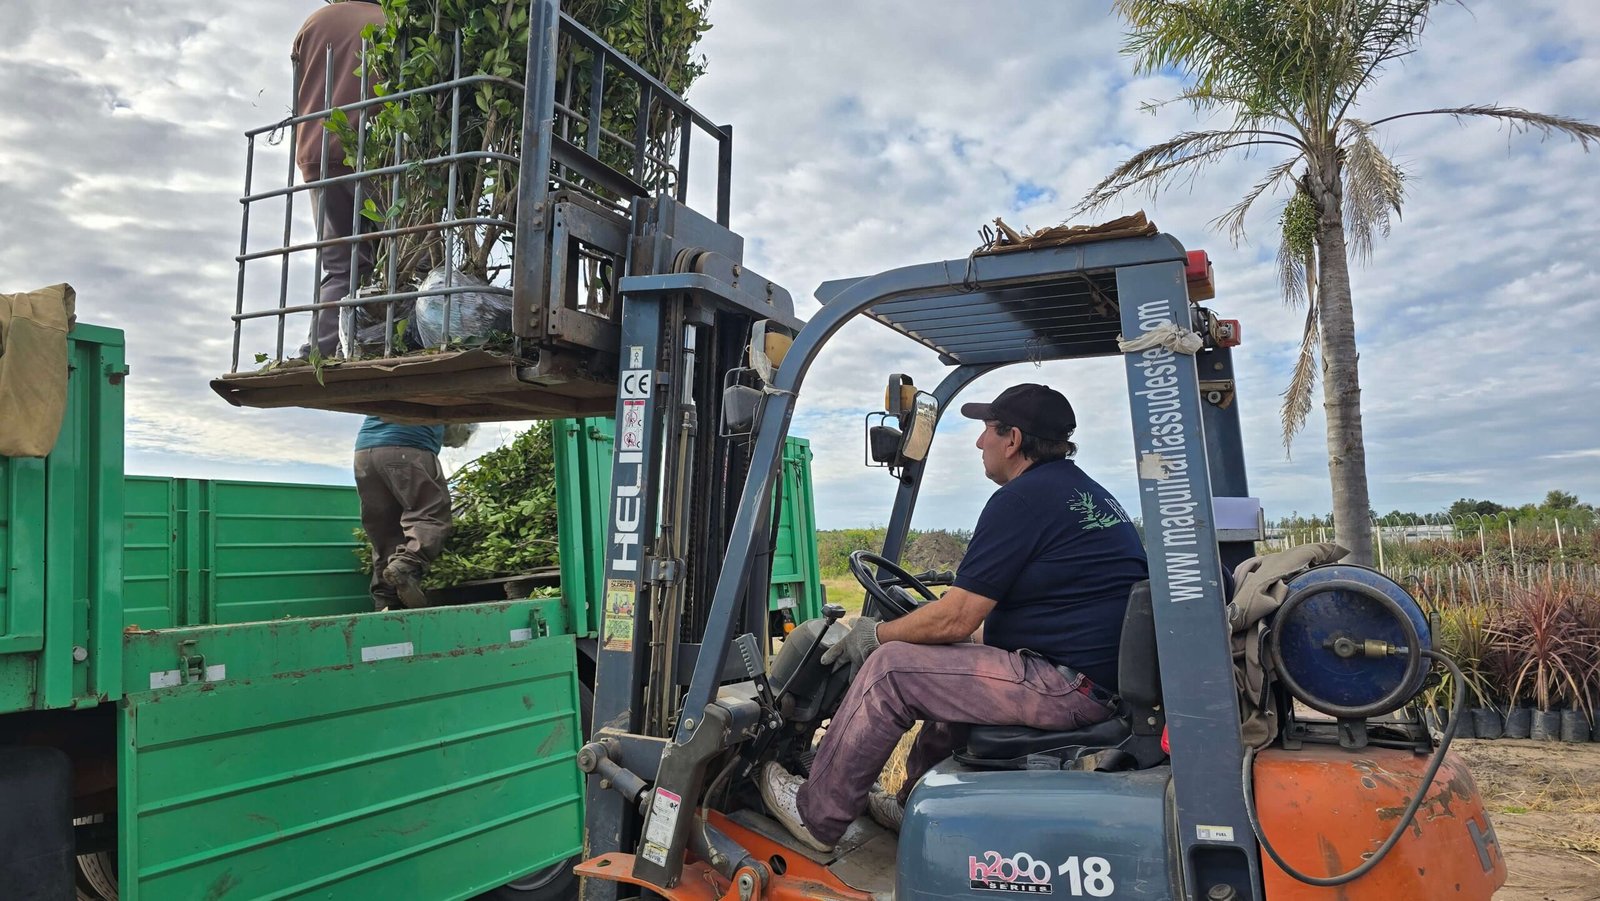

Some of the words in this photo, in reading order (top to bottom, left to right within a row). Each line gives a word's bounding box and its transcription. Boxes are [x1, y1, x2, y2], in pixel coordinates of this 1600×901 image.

[624, 374, 649, 394] CE
[612, 452, 643, 571] HELI
[969, 851, 1051, 884] h2000
[1058, 856, 1115, 897] 18
[989, 882, 1047, 892] SERIES
